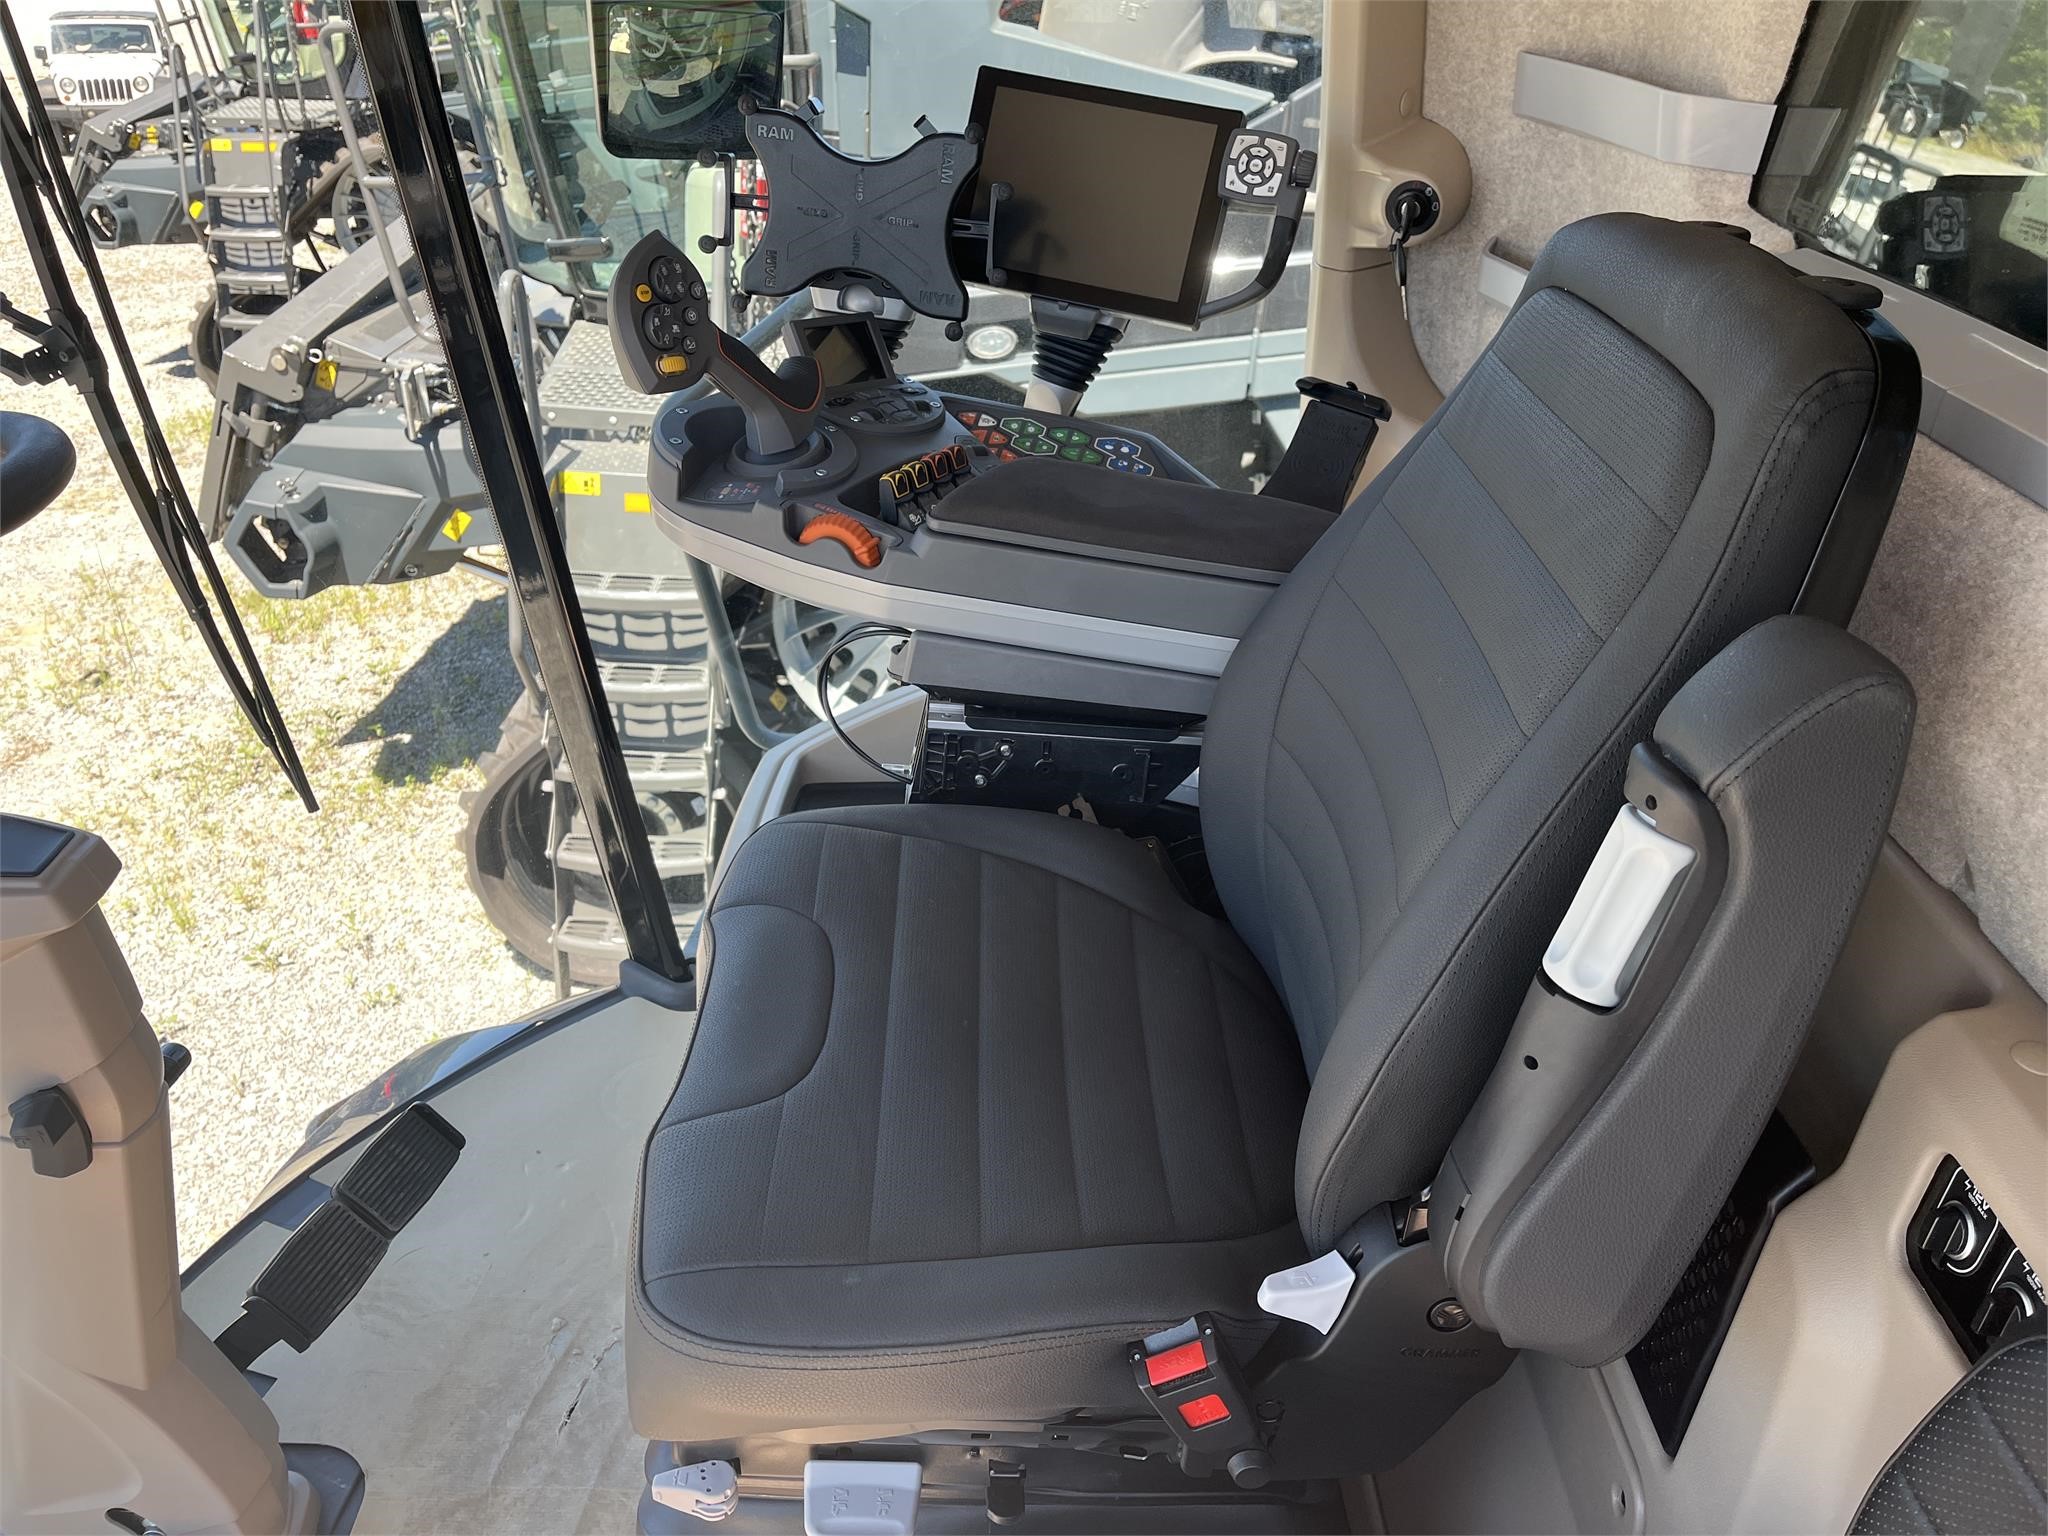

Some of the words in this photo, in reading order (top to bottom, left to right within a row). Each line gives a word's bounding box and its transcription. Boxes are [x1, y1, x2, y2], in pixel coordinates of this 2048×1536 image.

[757, 124, 794, 141] RAM
[941, 143, 954, 185] RAM
[765, 250, 778, 289] RAM
[919, 290, 956, 306] RAM
